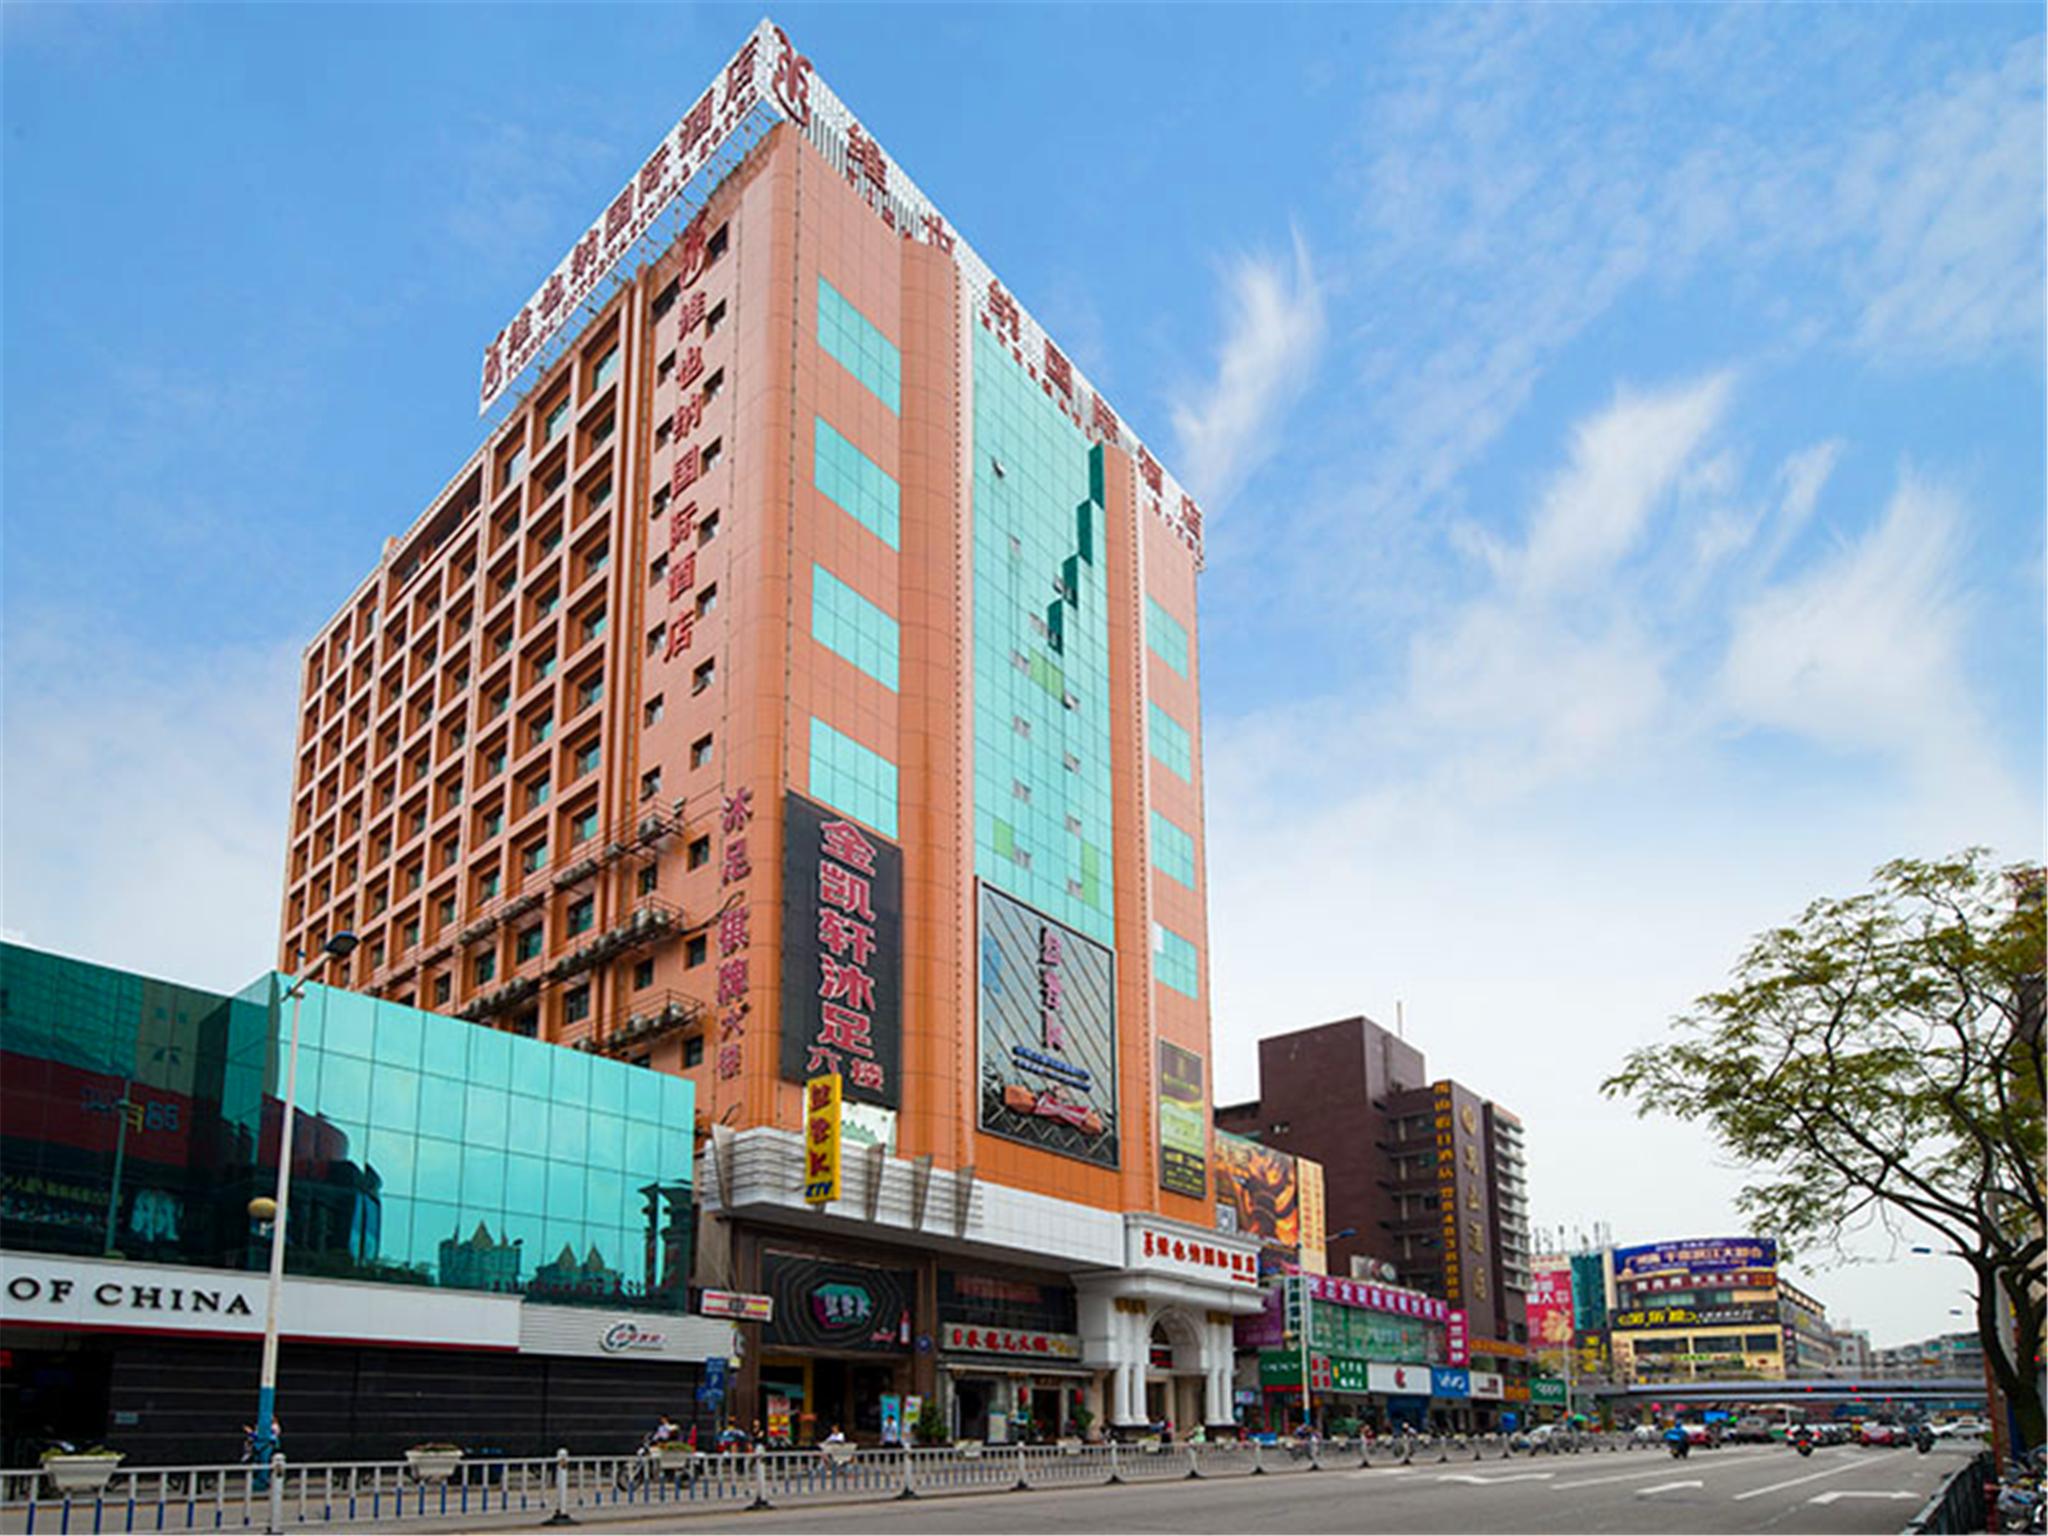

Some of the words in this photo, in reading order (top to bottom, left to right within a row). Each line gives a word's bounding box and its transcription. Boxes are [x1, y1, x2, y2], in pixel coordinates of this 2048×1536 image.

[818, 819, 878, 1058] 金凯轩沐足
[806, 1181, 832, 1197] KTV
[7, 1277, 74, 1302] OF
[94, 1283, 251, 1315] CHINA
